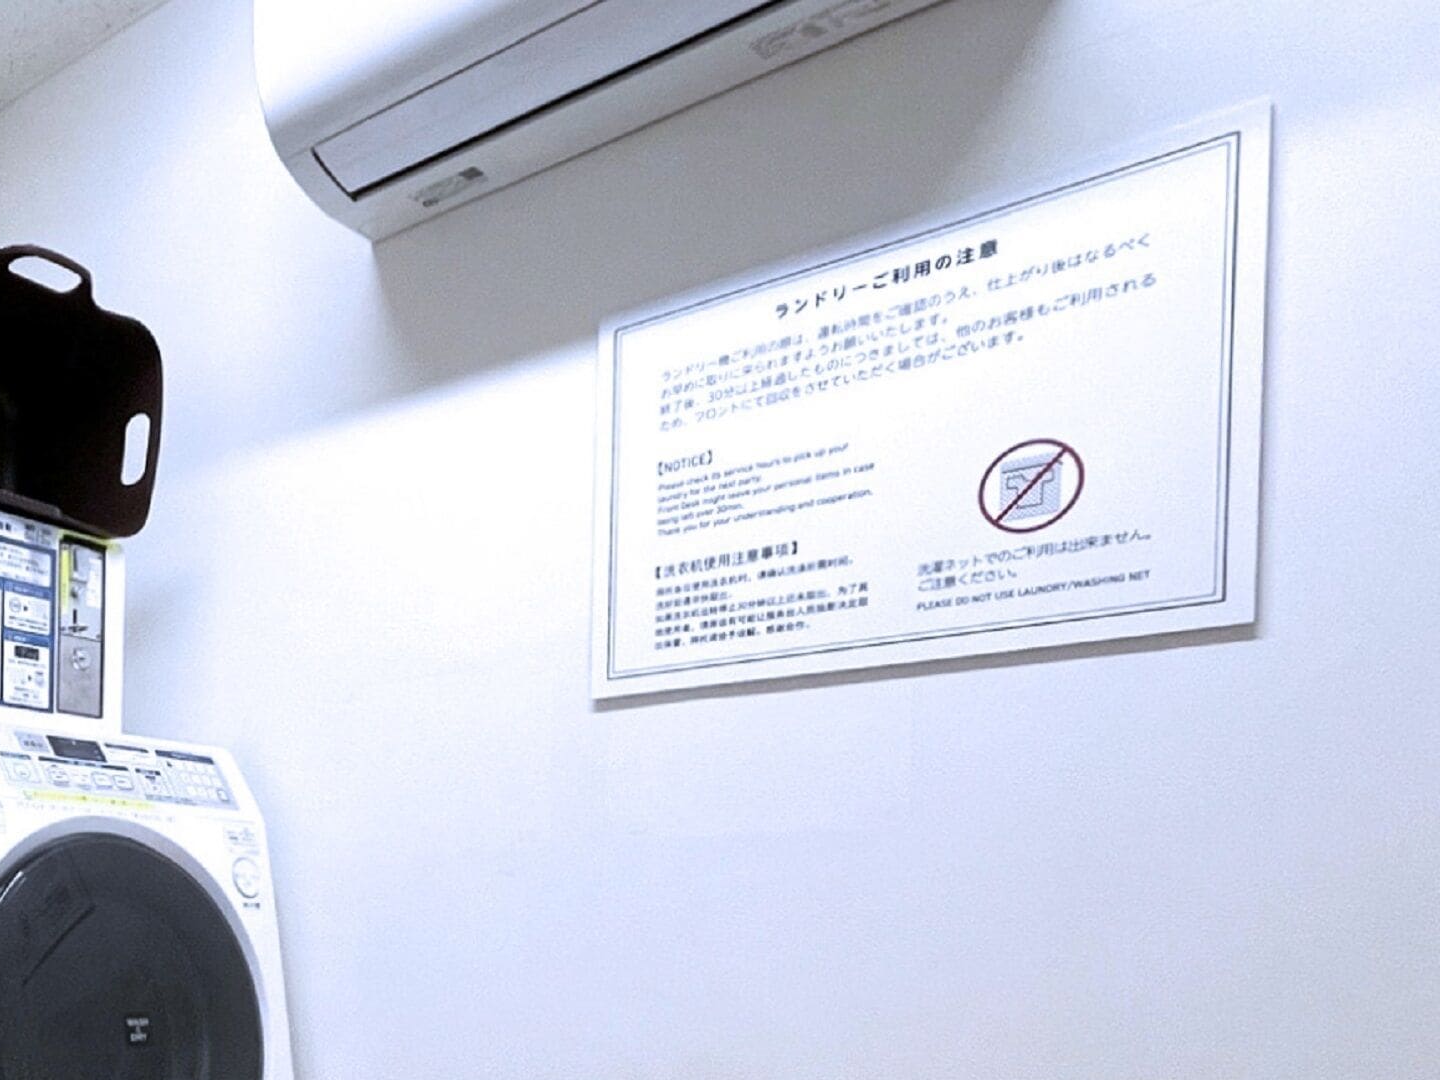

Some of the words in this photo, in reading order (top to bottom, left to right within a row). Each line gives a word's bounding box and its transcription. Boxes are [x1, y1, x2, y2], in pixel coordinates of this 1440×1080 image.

[775, 238, 998, 318] ランドリーご利用の注意
[915, 598, 952, 611] PLEASE
[954, 595, 970, 606] DO
[971, 591, 991, 604] NOT
[994, 588, 1014, 601] USE
[1128, 569, 1150, 582] NET
